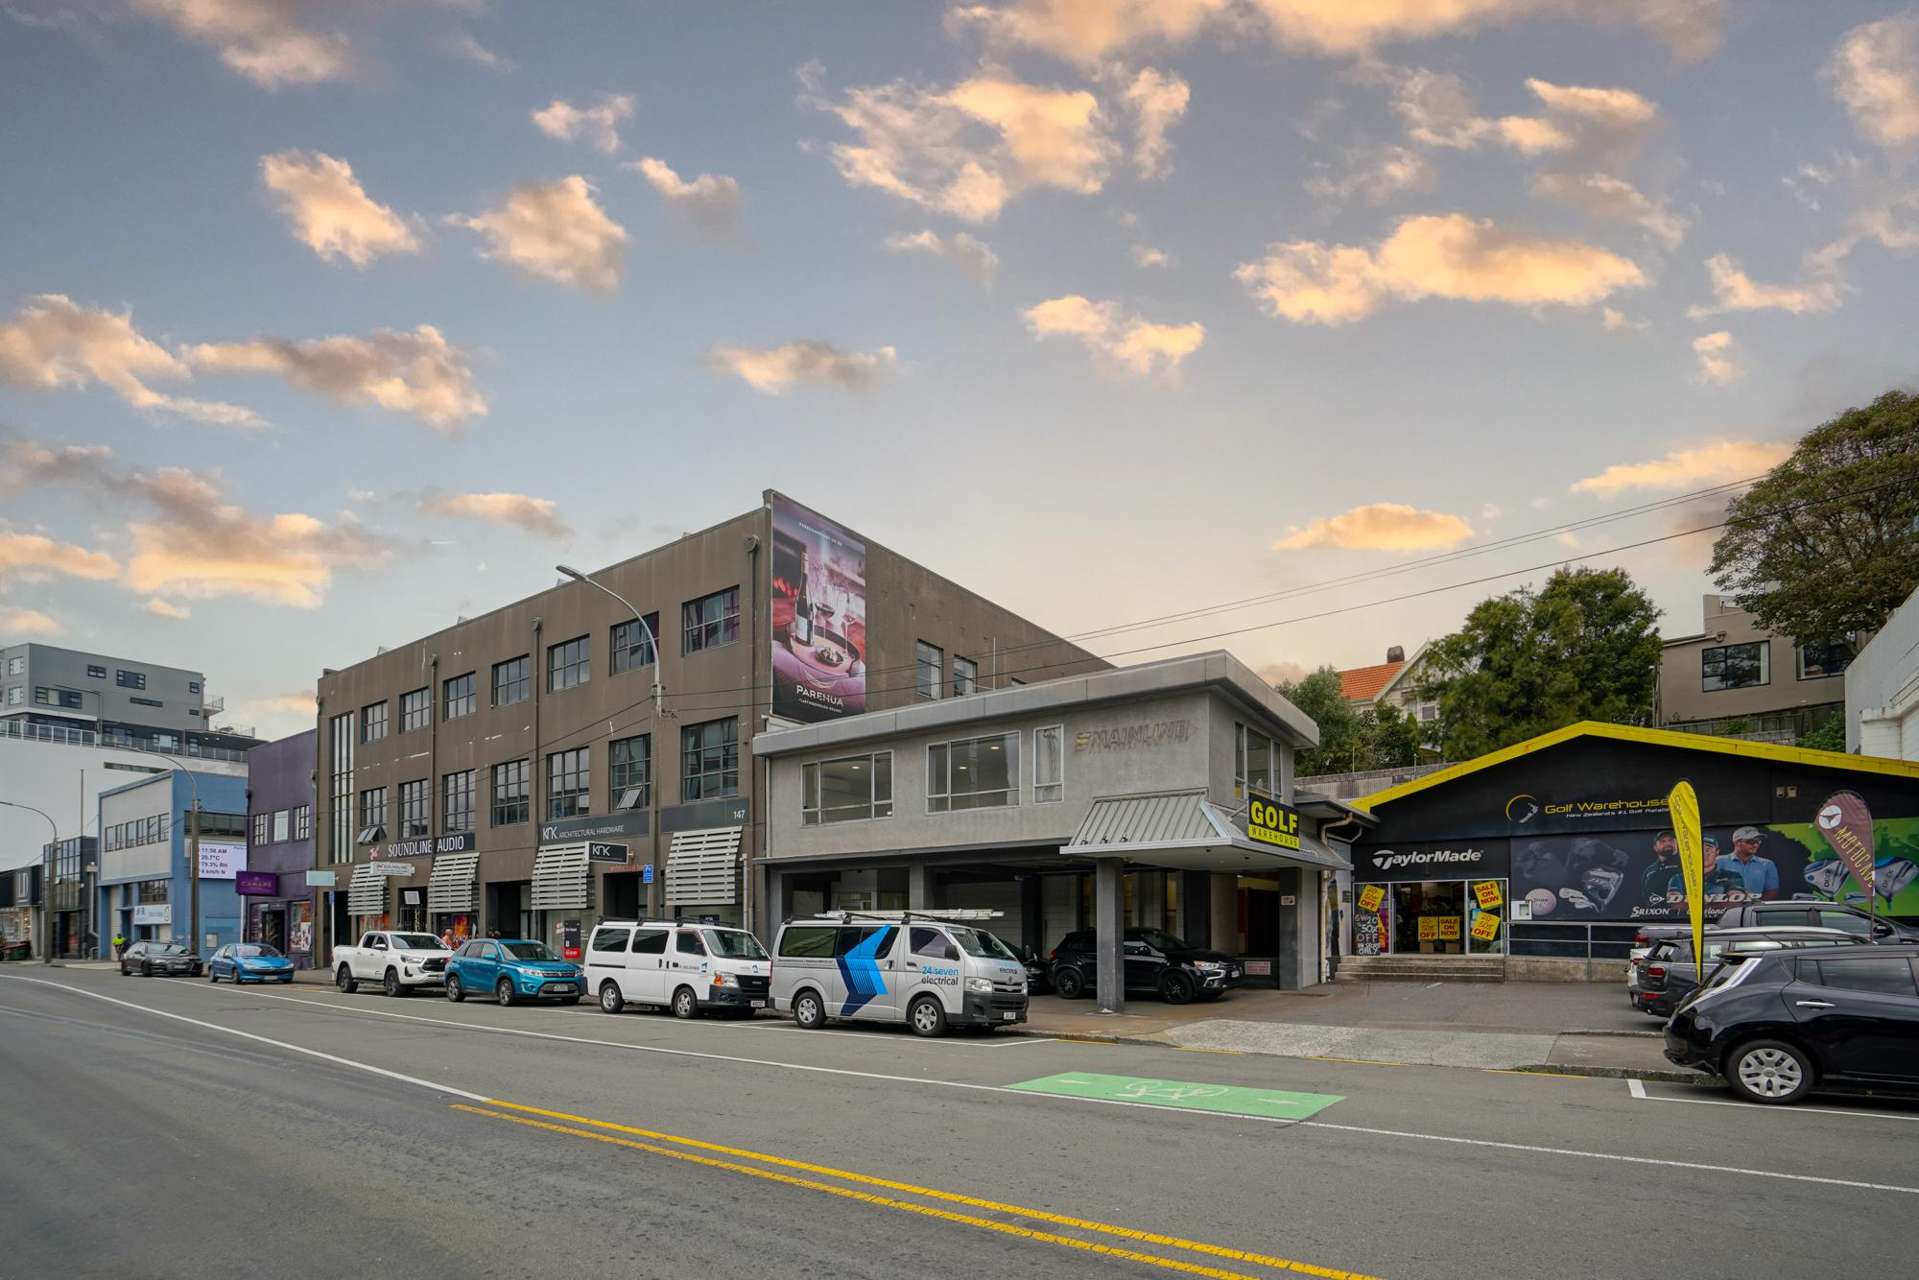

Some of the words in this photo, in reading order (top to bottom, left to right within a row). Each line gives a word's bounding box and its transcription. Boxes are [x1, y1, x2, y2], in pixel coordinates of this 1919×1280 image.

[796, 684, 844, 707] PAREHUA
[1544, 803, 1573, 814] Golf
[1577, 798, 1669, 811] Warehouse
[733, 809, 745, 820] 147
[1251, 800, 1298, 834] GOLF
[558, 828, 596, 839] ARCHITECTURAL
[596, 824, 625, 834] HARDWARE
[1250, 827, 1298, 847] WAREHOUSE
[388, 839, 433, 858] SOUNDLINE
[437, 835, 464, 852] AUDIO
[1372, 849, 1482, 870] TaylorMade
[1476, 882, 1496, 891] SALE
[1482, 890, 1494, 898] ON
[1667, 890, 1763, 903] DNLOP
[1360, 899, 1377, 908] OFF
[1480, 896, 1499, 904] NOW
[1630, 906, 1670, 918] SRIXON
[1356, 933, 1378, 942] OFF
[1474, 927, 1494, 938] OFF
[935, 967, 959, 976] seven
[921, 975, 959, 986] electrical
